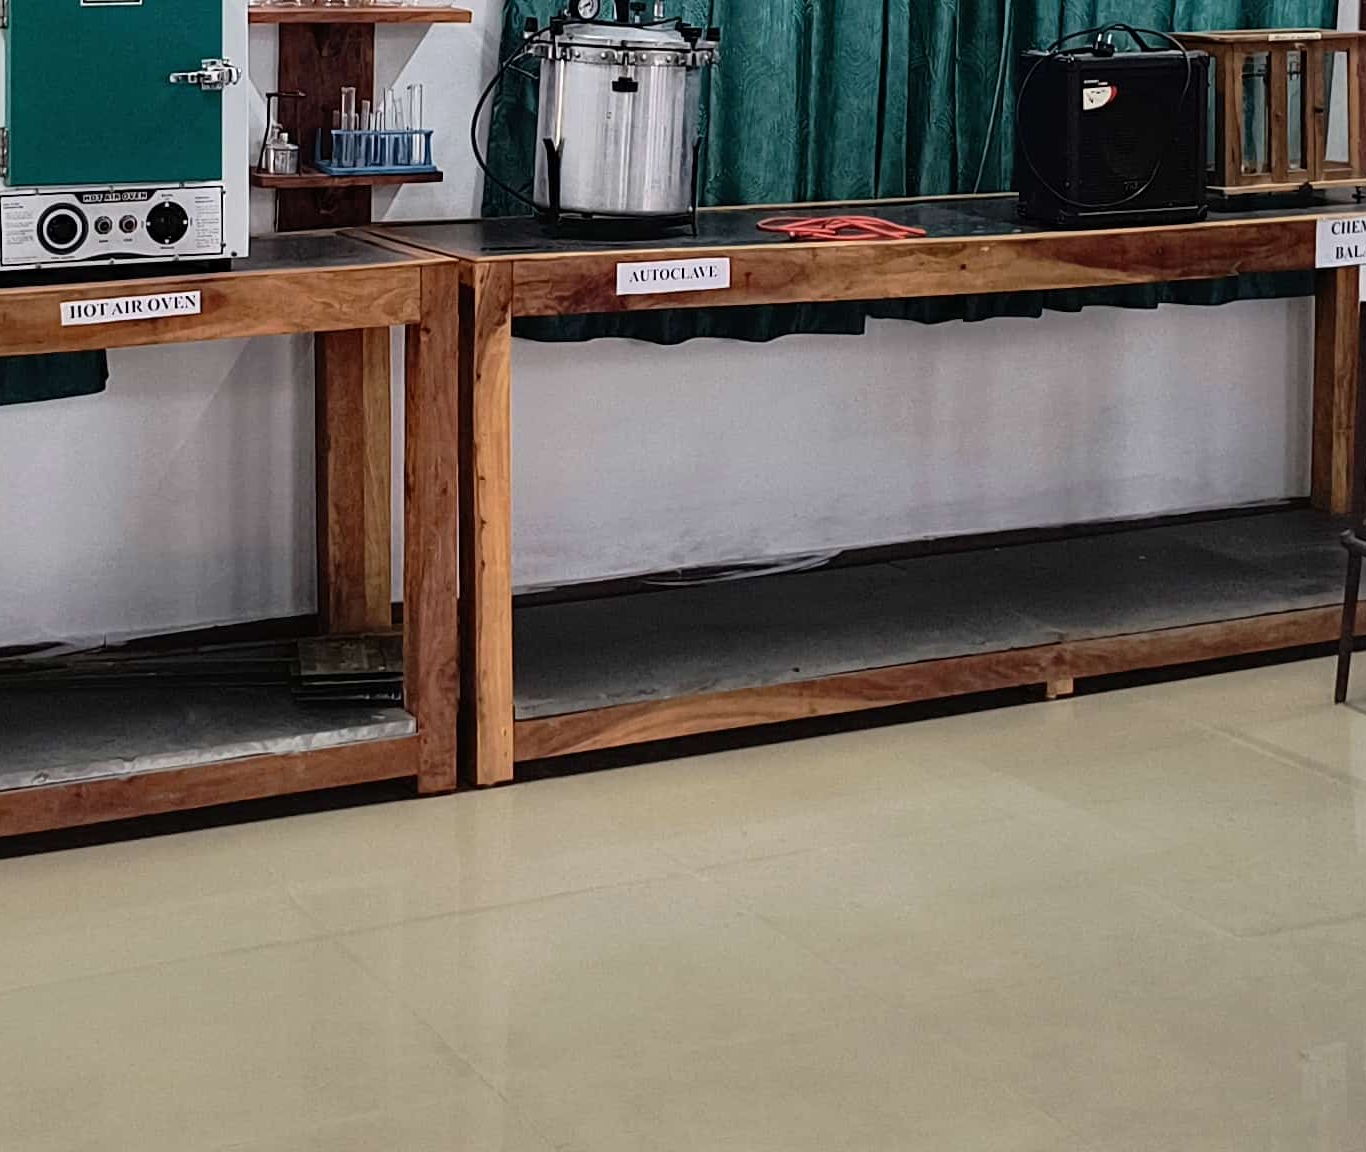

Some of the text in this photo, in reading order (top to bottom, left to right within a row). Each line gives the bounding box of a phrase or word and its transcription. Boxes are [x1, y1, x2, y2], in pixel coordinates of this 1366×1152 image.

[83, 191, 148, 203] HOT AIR OVEN
[629, 265, 717, 283] AUTOCLAVE
[70, 295, 196, 319] HOT AIR OVEN
